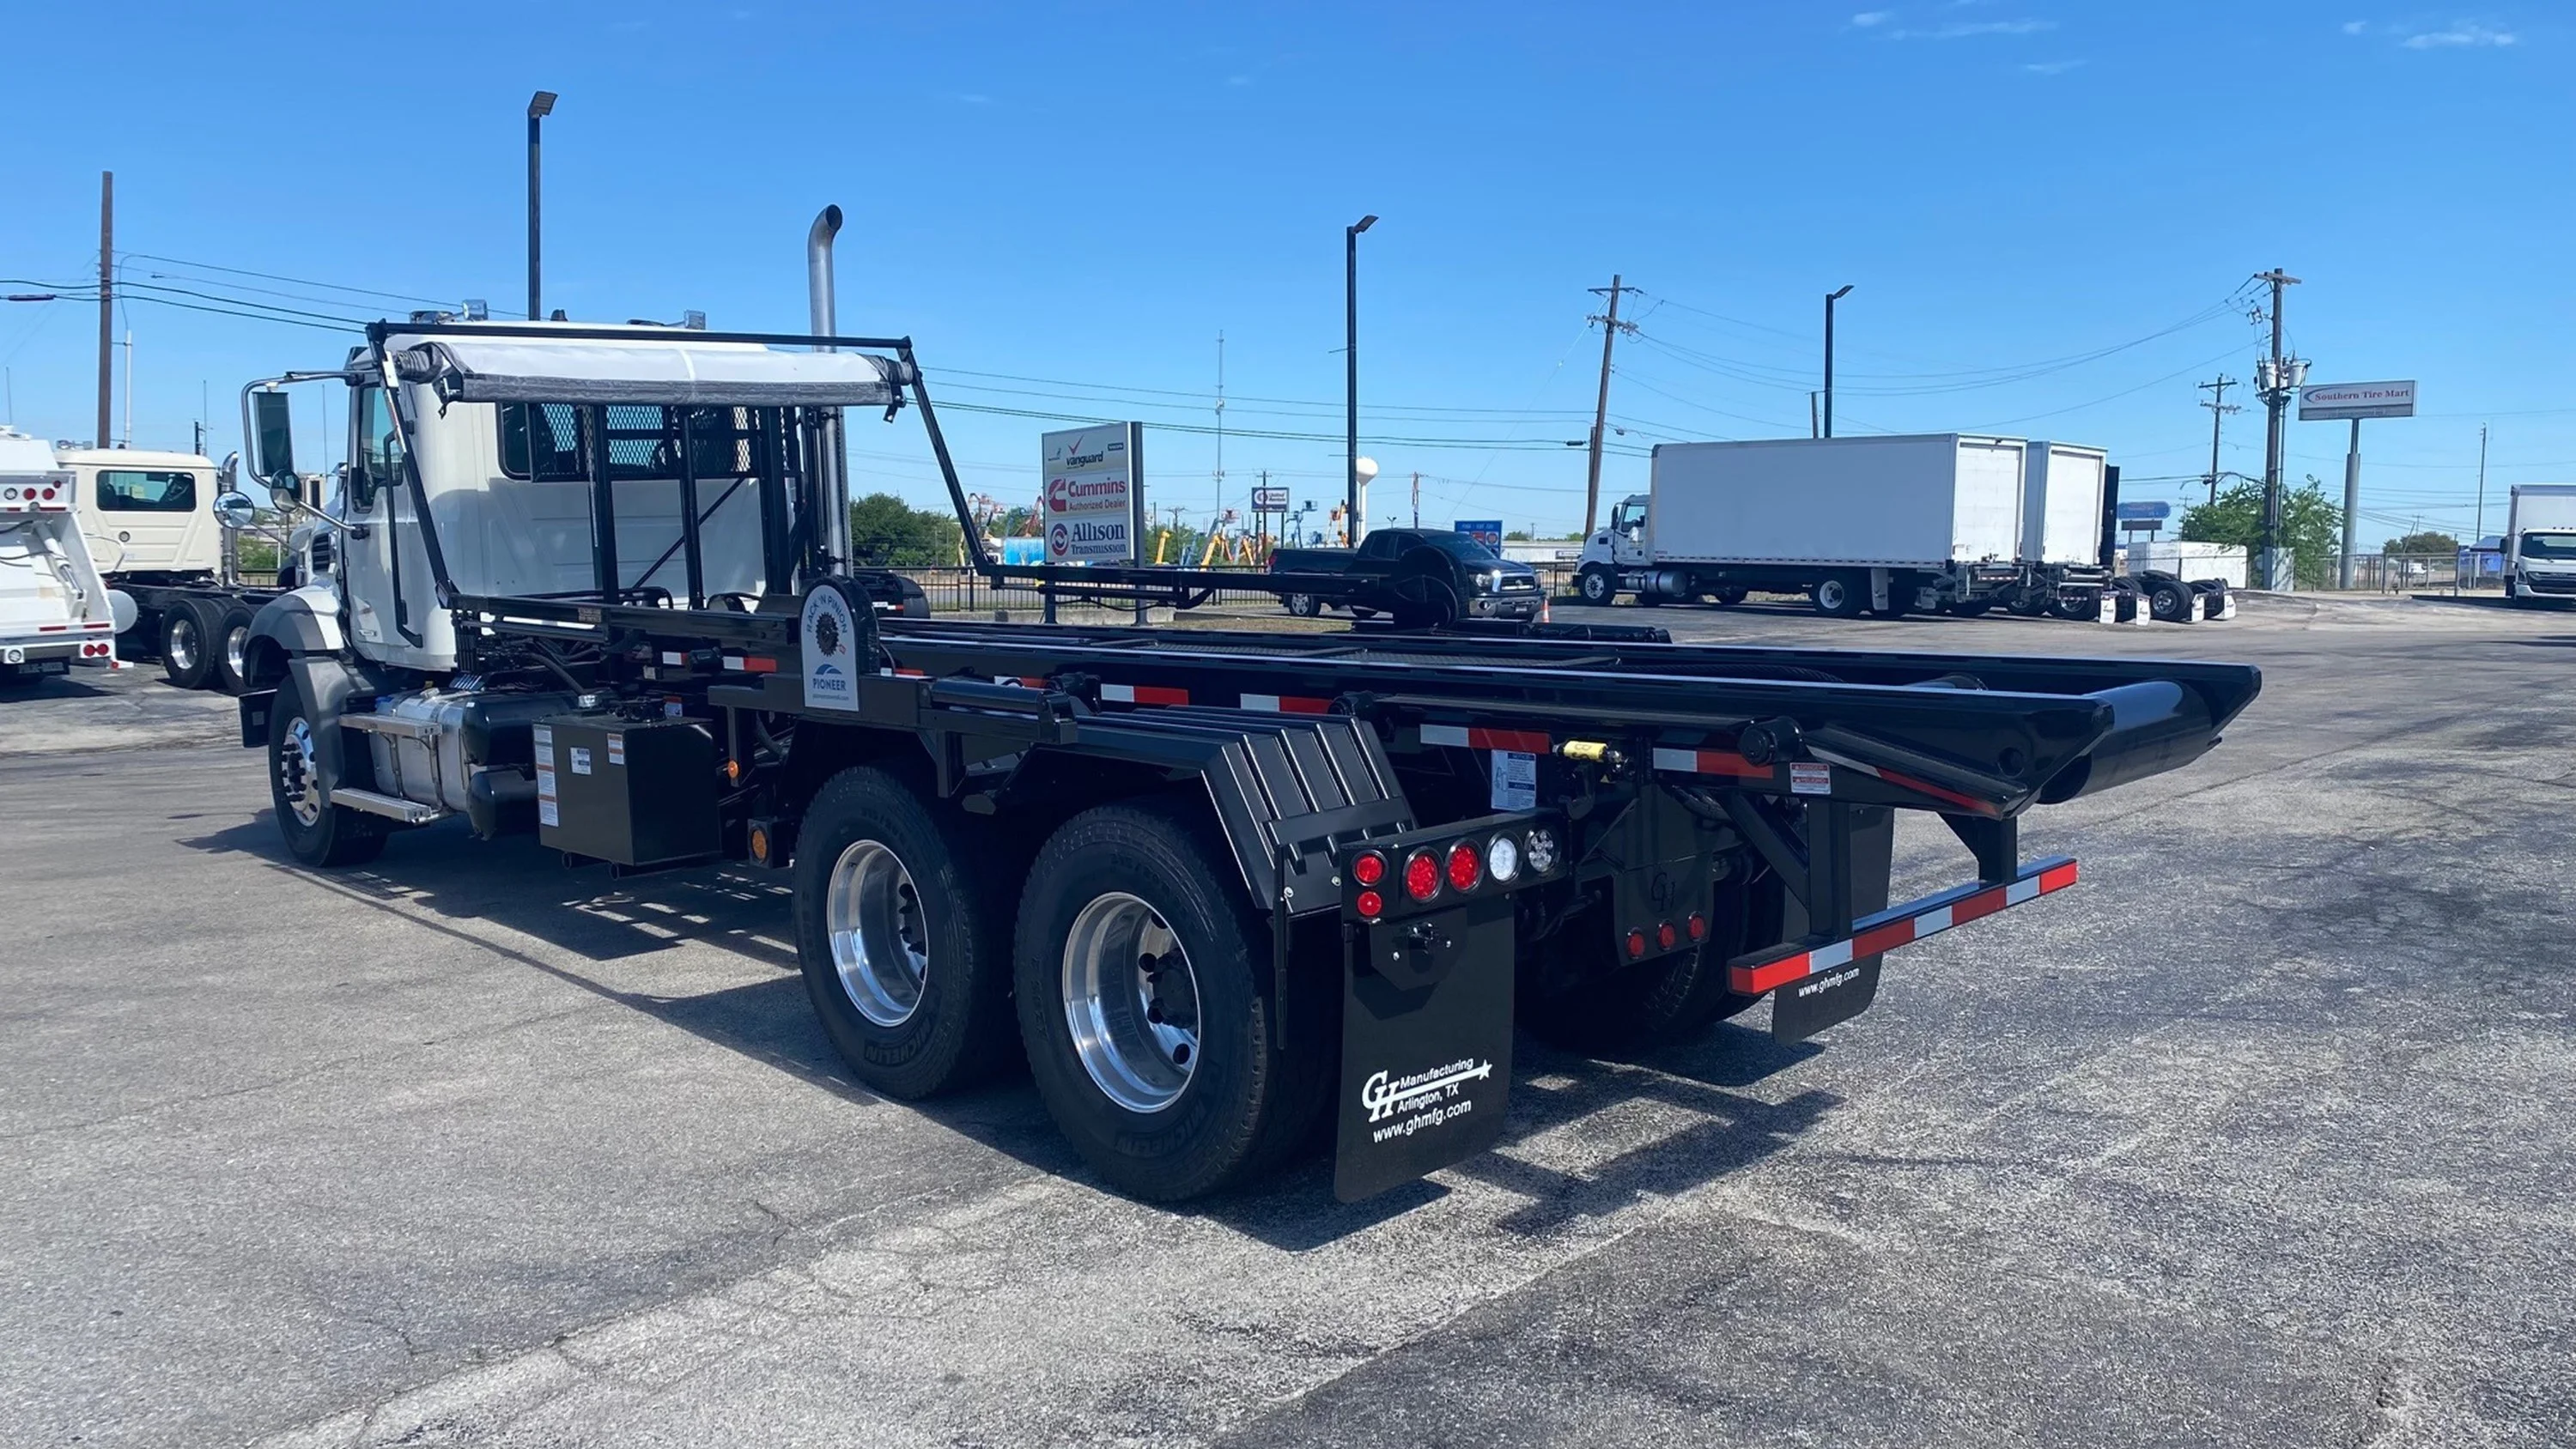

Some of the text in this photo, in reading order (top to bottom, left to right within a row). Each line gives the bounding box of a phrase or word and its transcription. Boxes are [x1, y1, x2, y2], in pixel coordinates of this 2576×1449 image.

[2315, 389, 2409, 402] Southern Tire Mart
[1066, 451, 1103, 467] vanguard
[1068, 477, 1127, 497] Cummins
[1069, 499, 1127, 511] Authorized Dealer
[1071, 522, 1127, 543] Allison
[1071, 543, 1127, 555] Transmission
[812, 677, 847, 691] PIONEER
[1798, 967, 1860, 997] www.ghmfg.com
[1400, 1058, 1474, 1089] Manufacturing
[1397, 1082, 1460, 1114] Arlington, TX
[1373, 1100, 1472, 1143] www.ghmfg.com
